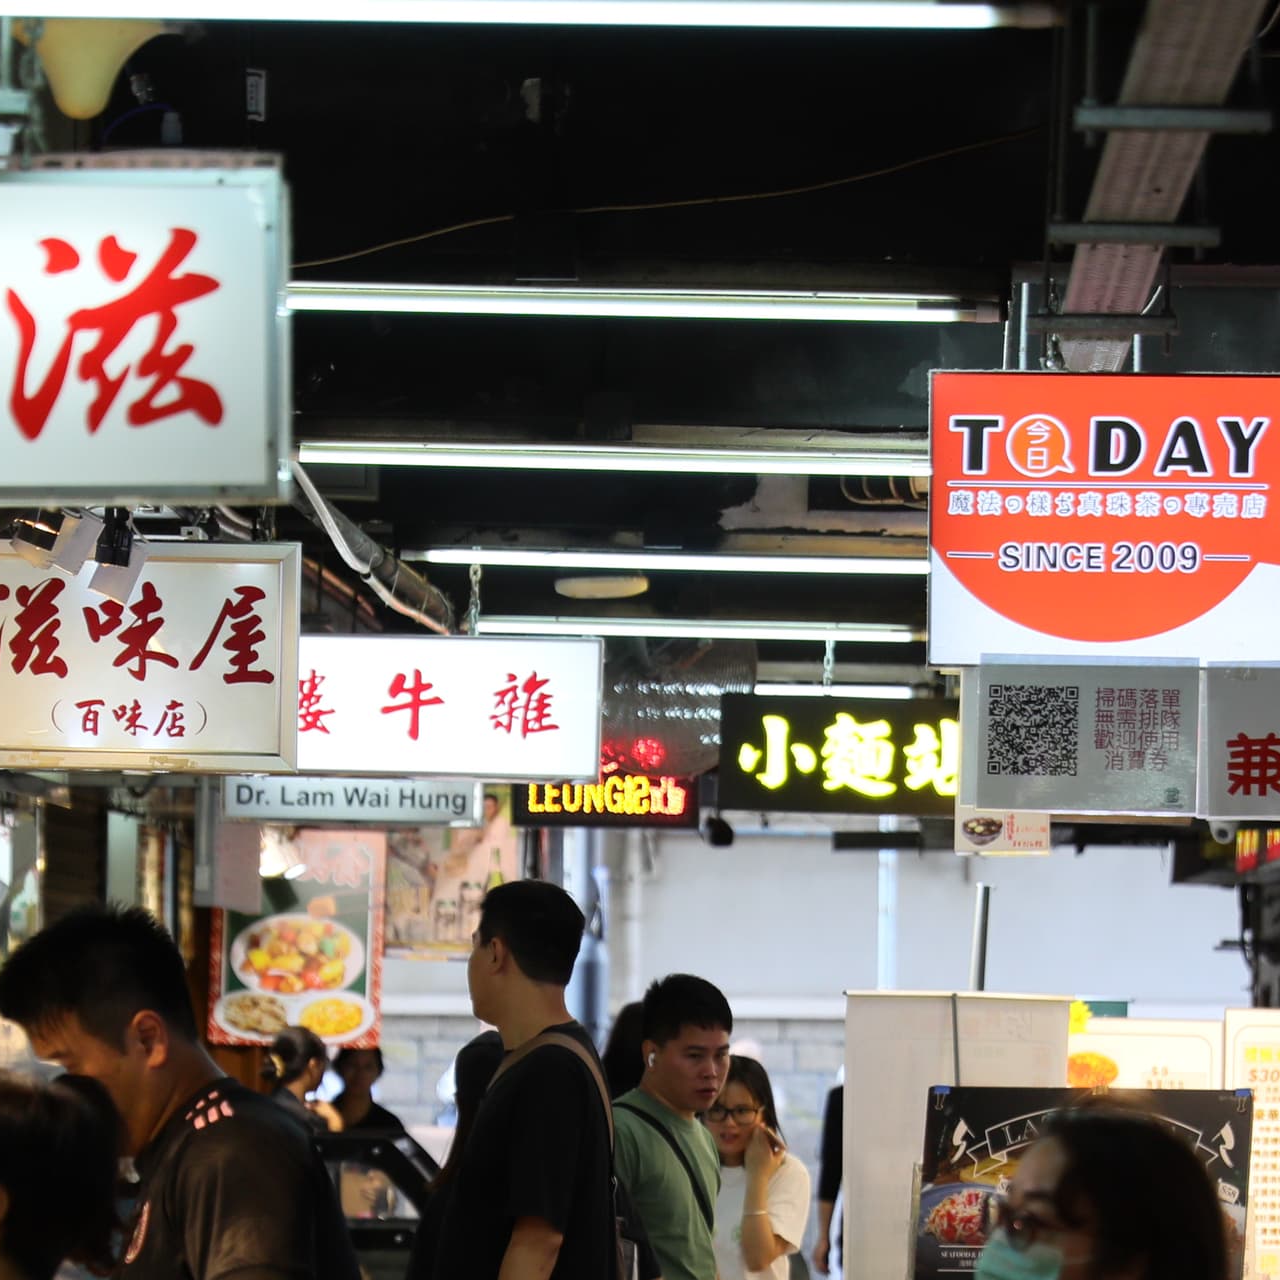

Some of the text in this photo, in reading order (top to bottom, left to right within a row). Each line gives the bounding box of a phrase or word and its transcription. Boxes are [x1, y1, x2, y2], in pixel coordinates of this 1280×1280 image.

[999, 542, 1200, 573] SINCE 2009
[1094, 729, 1180, 750] 歡迎使用
[235, 784, 467, 814] Dr. Lam Wai Hung
